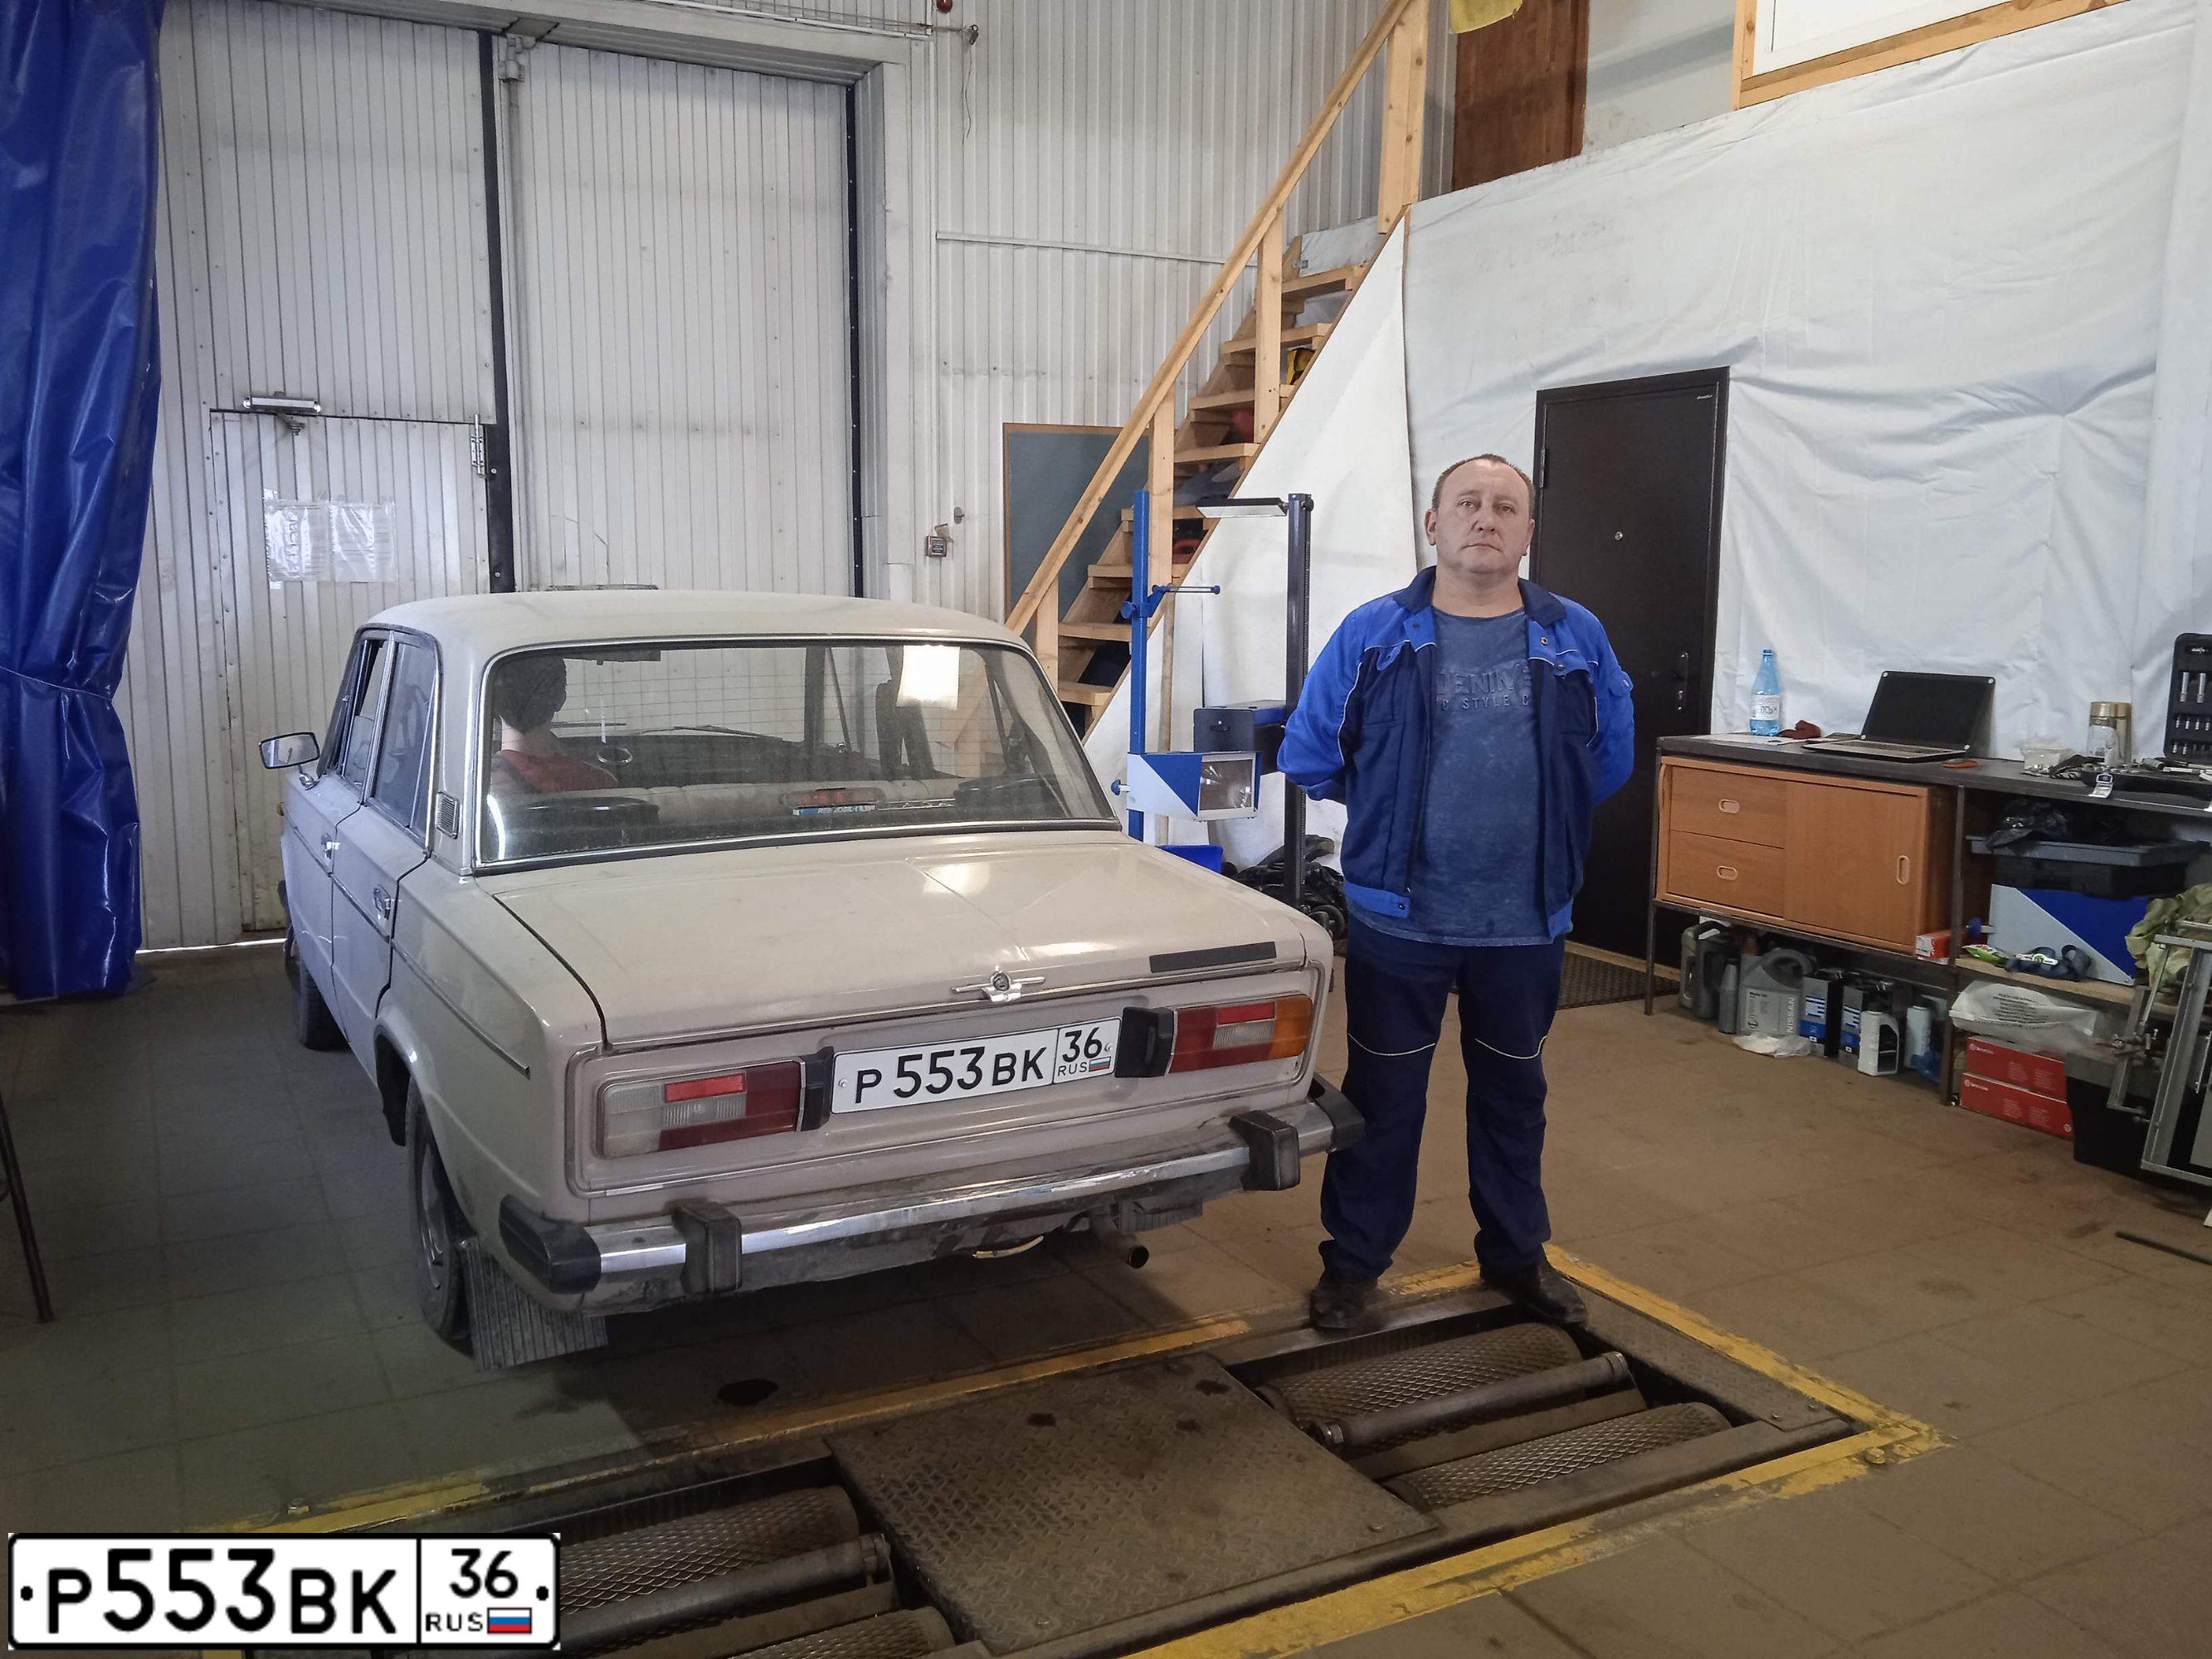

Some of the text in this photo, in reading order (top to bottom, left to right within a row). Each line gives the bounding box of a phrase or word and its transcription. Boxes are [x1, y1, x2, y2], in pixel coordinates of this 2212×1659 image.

[1463, 695, 1509, 709] STYLE
[1786, 997, 1795, 1033] NISSAN
[1061, 1027, 1102, 1063] 36
[1057, 1063, 1089, 1077] RUS
